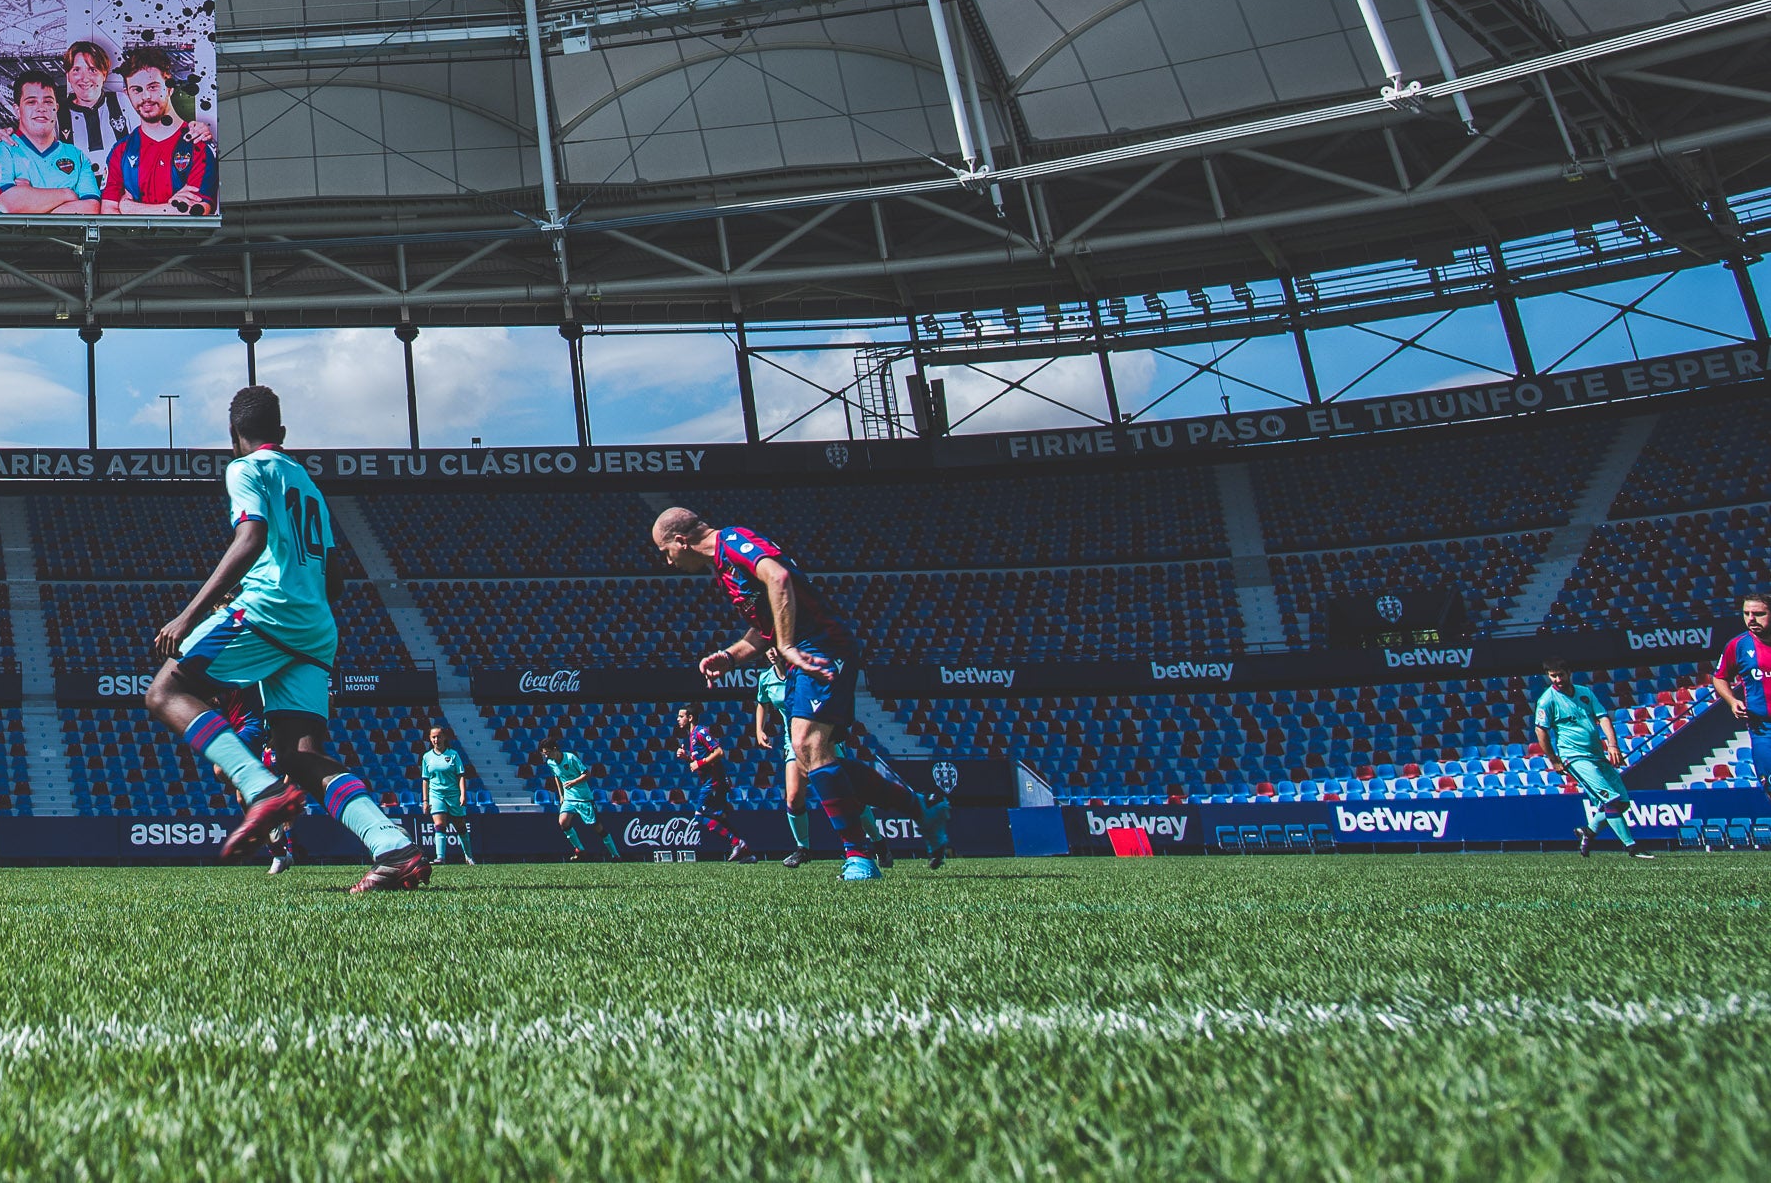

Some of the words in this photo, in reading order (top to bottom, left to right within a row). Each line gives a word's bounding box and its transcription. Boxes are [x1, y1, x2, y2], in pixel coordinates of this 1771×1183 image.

[1009, 431, 1116, 458] FIRME
[1127, 425, 1174, 450] TU
[1186, 414, 1286, 444] PASO
[1306, 407, 1354, 433] EL
[1364, 382, 1544, 426] TRIUNFO
[1553, 372, 1609, 401] TE
[1621, 346, 1771, 392] ESPER
[336, 454, 378, 476] DE
[387, 454, 427, 476] TU
[439, 449, 577, 476] CLÁSICO
[588, 450, 706, 474] JERSEY
[1627, 625, 1713, 650] betway
[1384, 647, 1473, 668] betway
[345, 675, 380, 683] LEVANTE
[519, 669, 581, 693] Coca-Cola
[940, 666, 1015, 688] betway
[1151, 661, 1234, 682] betway
[97, 675, 154, 696] asis
[624, 817, 702, 847] Coca-Cola
[1335, 805, 1449, 838] betway
[131, 823, 206, 845] asisa
